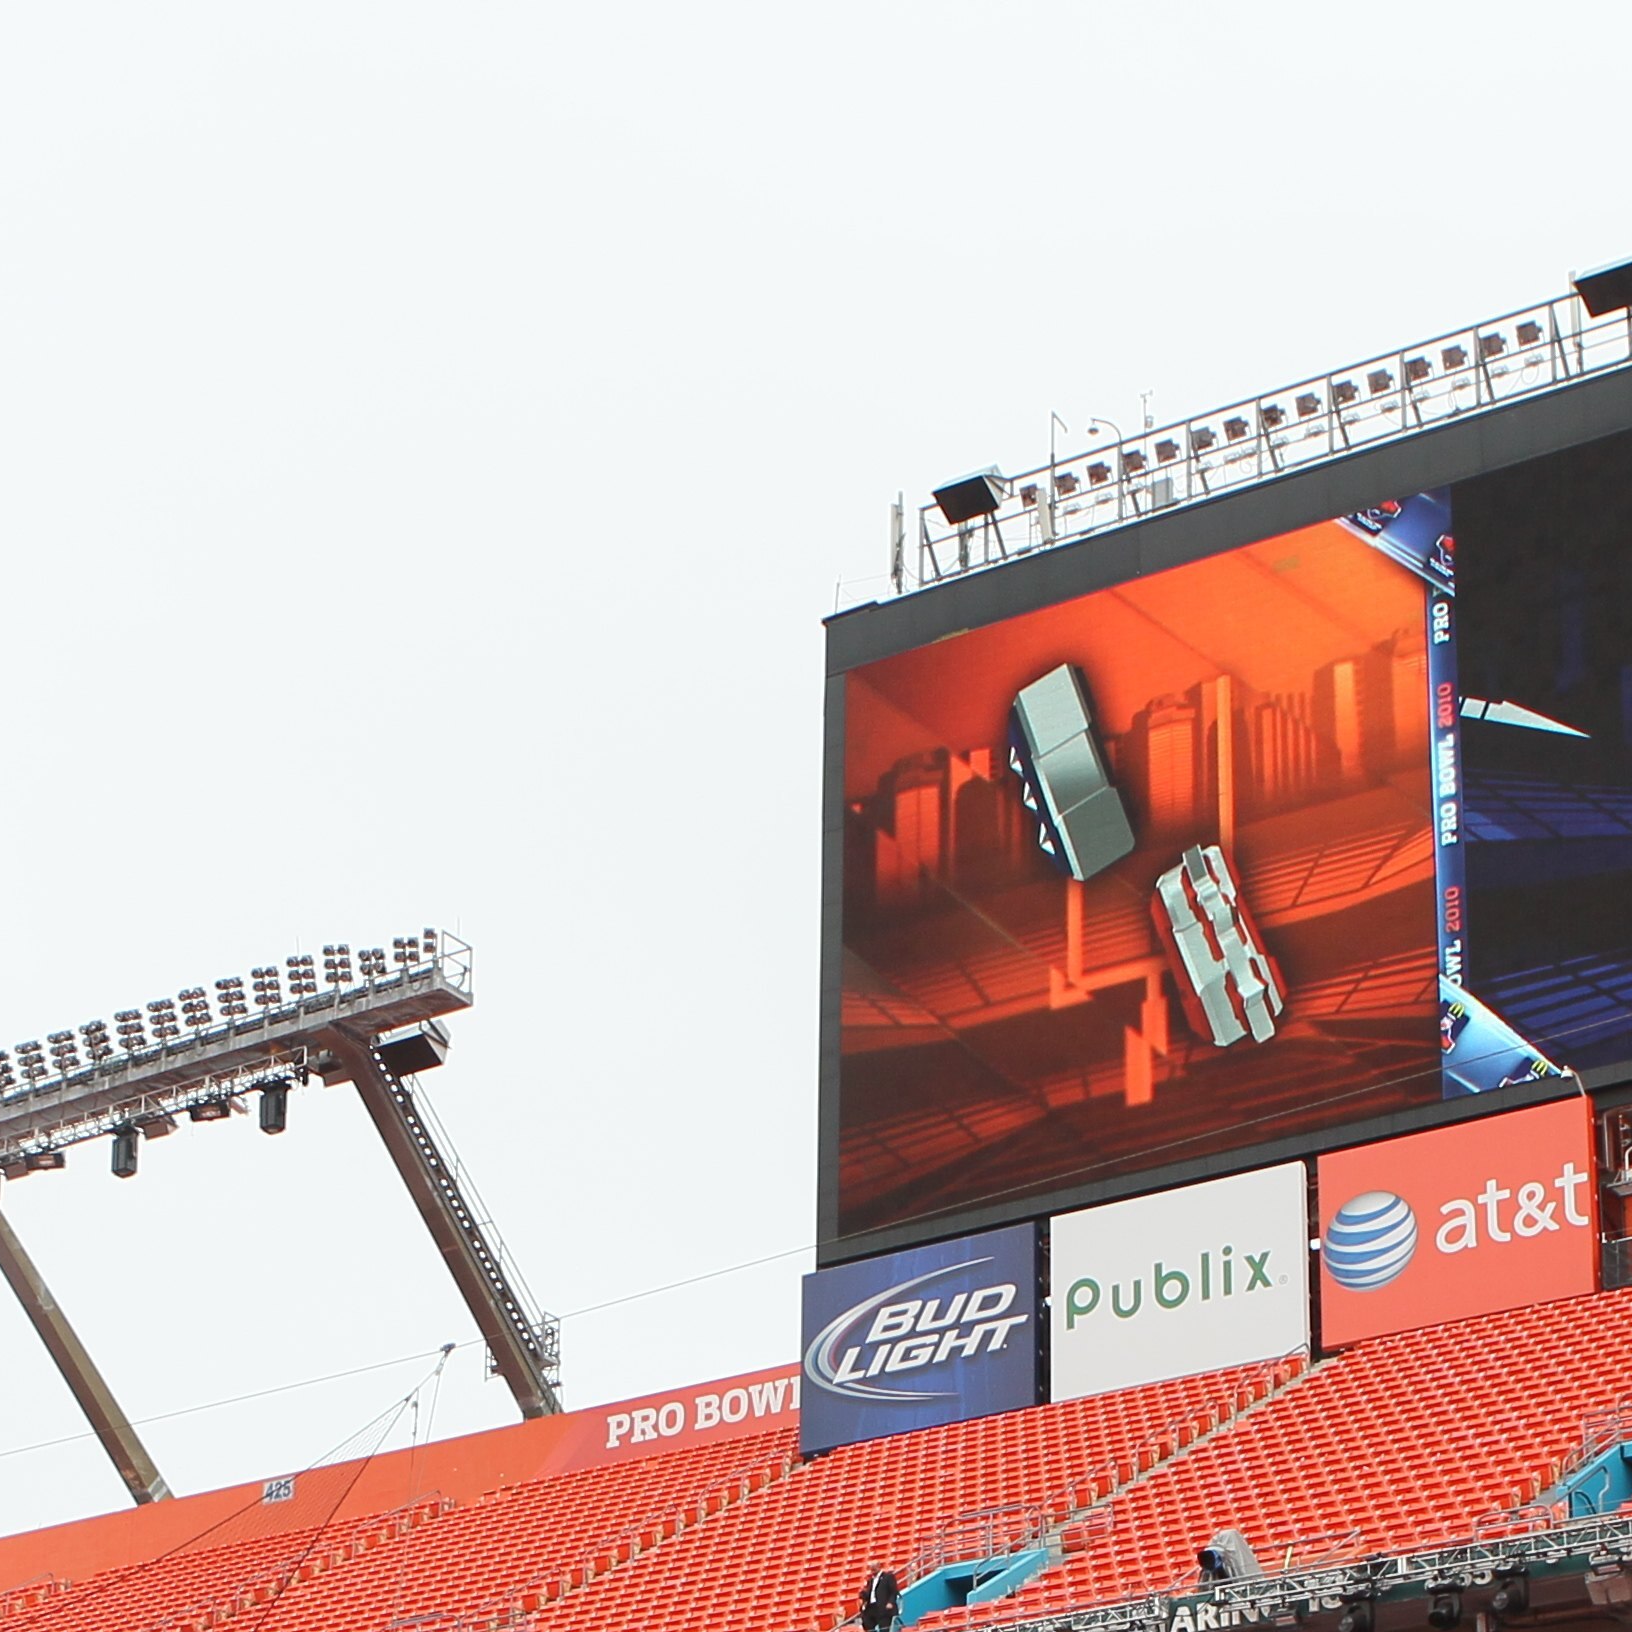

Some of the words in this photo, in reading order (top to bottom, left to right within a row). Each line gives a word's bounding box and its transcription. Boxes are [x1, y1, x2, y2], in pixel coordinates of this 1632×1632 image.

[1432, 602, 1450, 645] PRO
[1437, 683, 1453, 728] 2010
[1438, 734, 1458, 798] BOWL
[1439, 801, 1459, 846] PRO
[1444, 887, 1461, 933] 2010
[1442, 940, 1462, 987] OWL
[1435, 1162, 1590, 1254] at&t
[865, 1283, 1017, 1344] BUD
[832, 1314, 1030, 1385] LIGHT
[606, 1402, 684, 1449] PRO
[266, 1477, 293, 1502] 425
